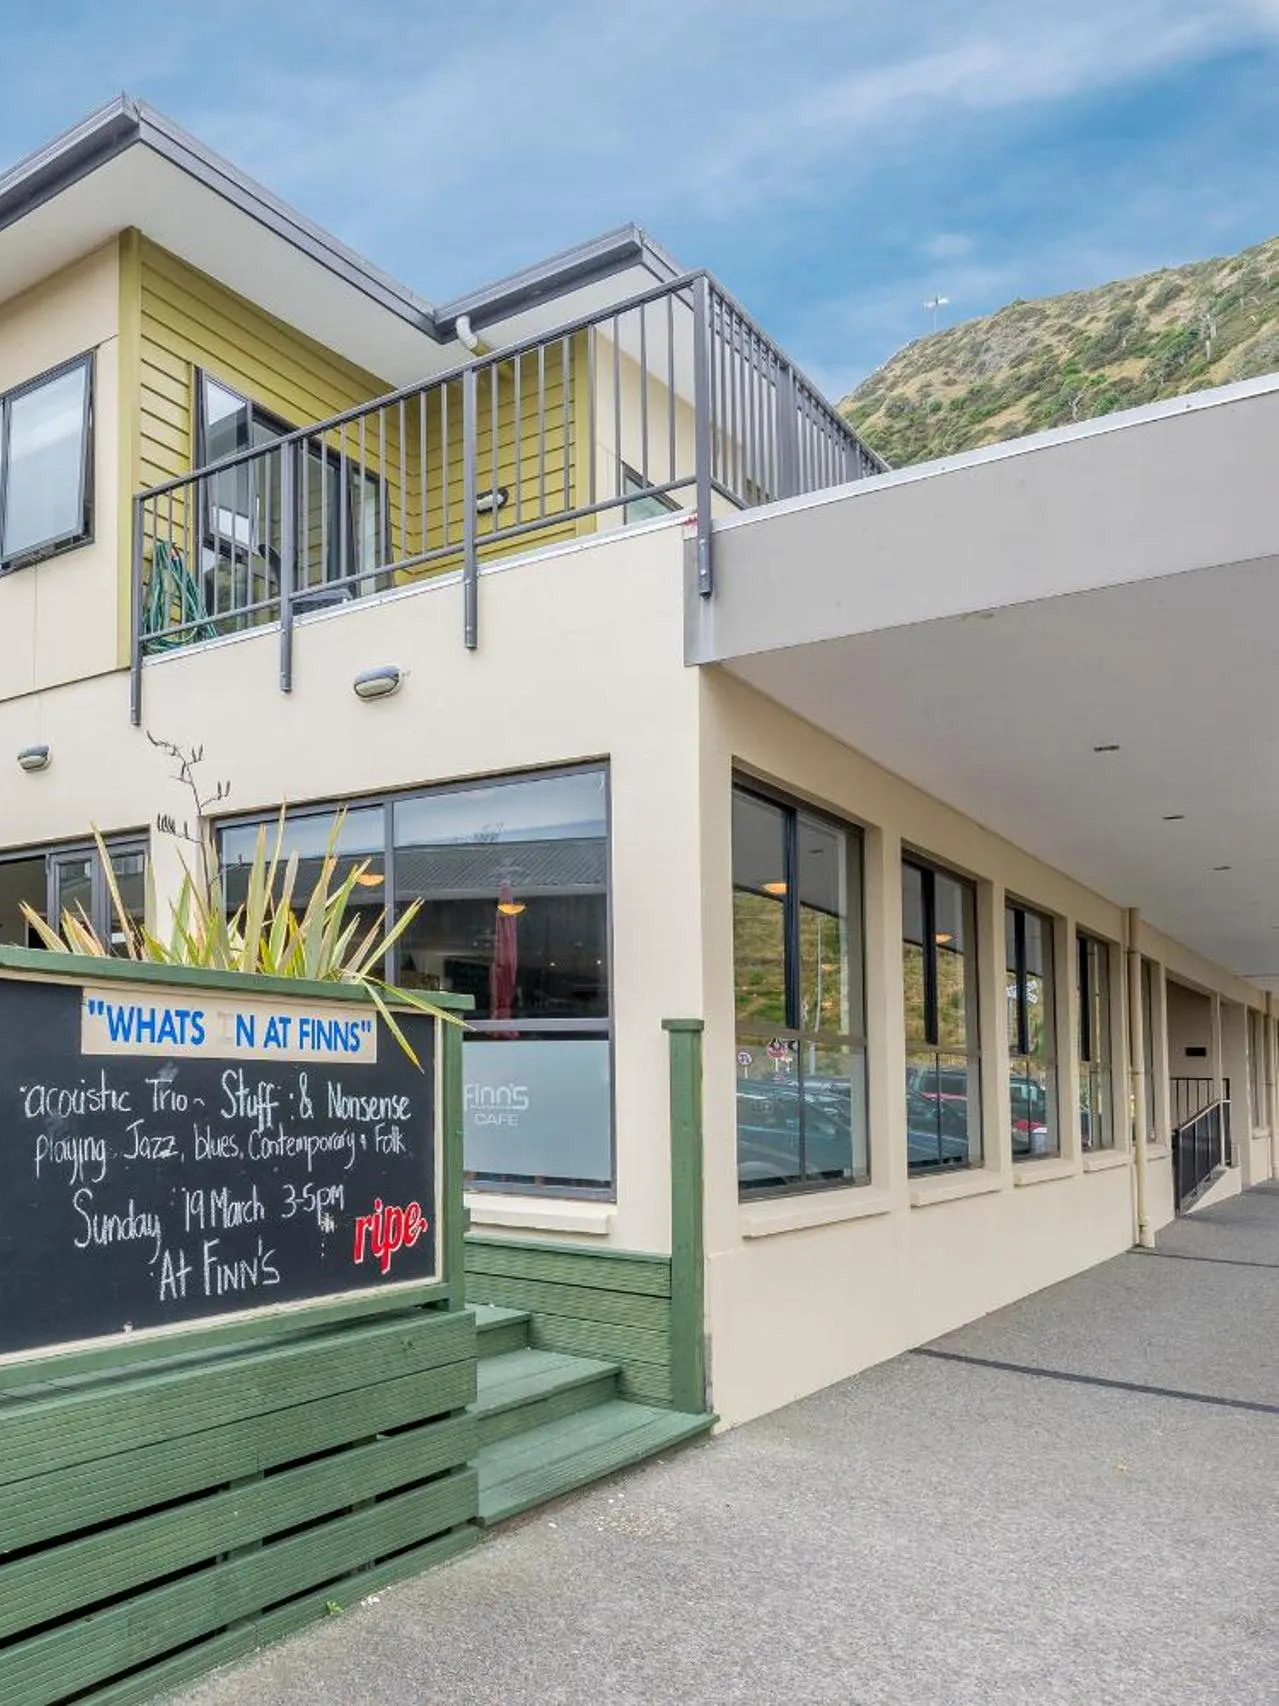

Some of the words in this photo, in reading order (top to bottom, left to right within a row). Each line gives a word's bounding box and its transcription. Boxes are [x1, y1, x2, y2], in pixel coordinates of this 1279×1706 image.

[88, 1000, 205, 1045] "WHATS
[263, 1016, 292, 1049] AT
[299, 1017, 372, 1052] FINNS"
[220, 1068, 279, 1132] Stuff
[299, 1071, 315, 1119] &
[327, 1080, 412, 1122] Nonsense
[34, 1134, 107, 1185] playing
[375, 1122, 406, 1155] Folk
[73, 1188, 161, 1265] Sunday
[185, 1189, 205, 1232] 19
[210, 1184, 265, 1229] March
[353, 1197, 427, 1275] ripe
[159, 1249, 193, 1301] At
